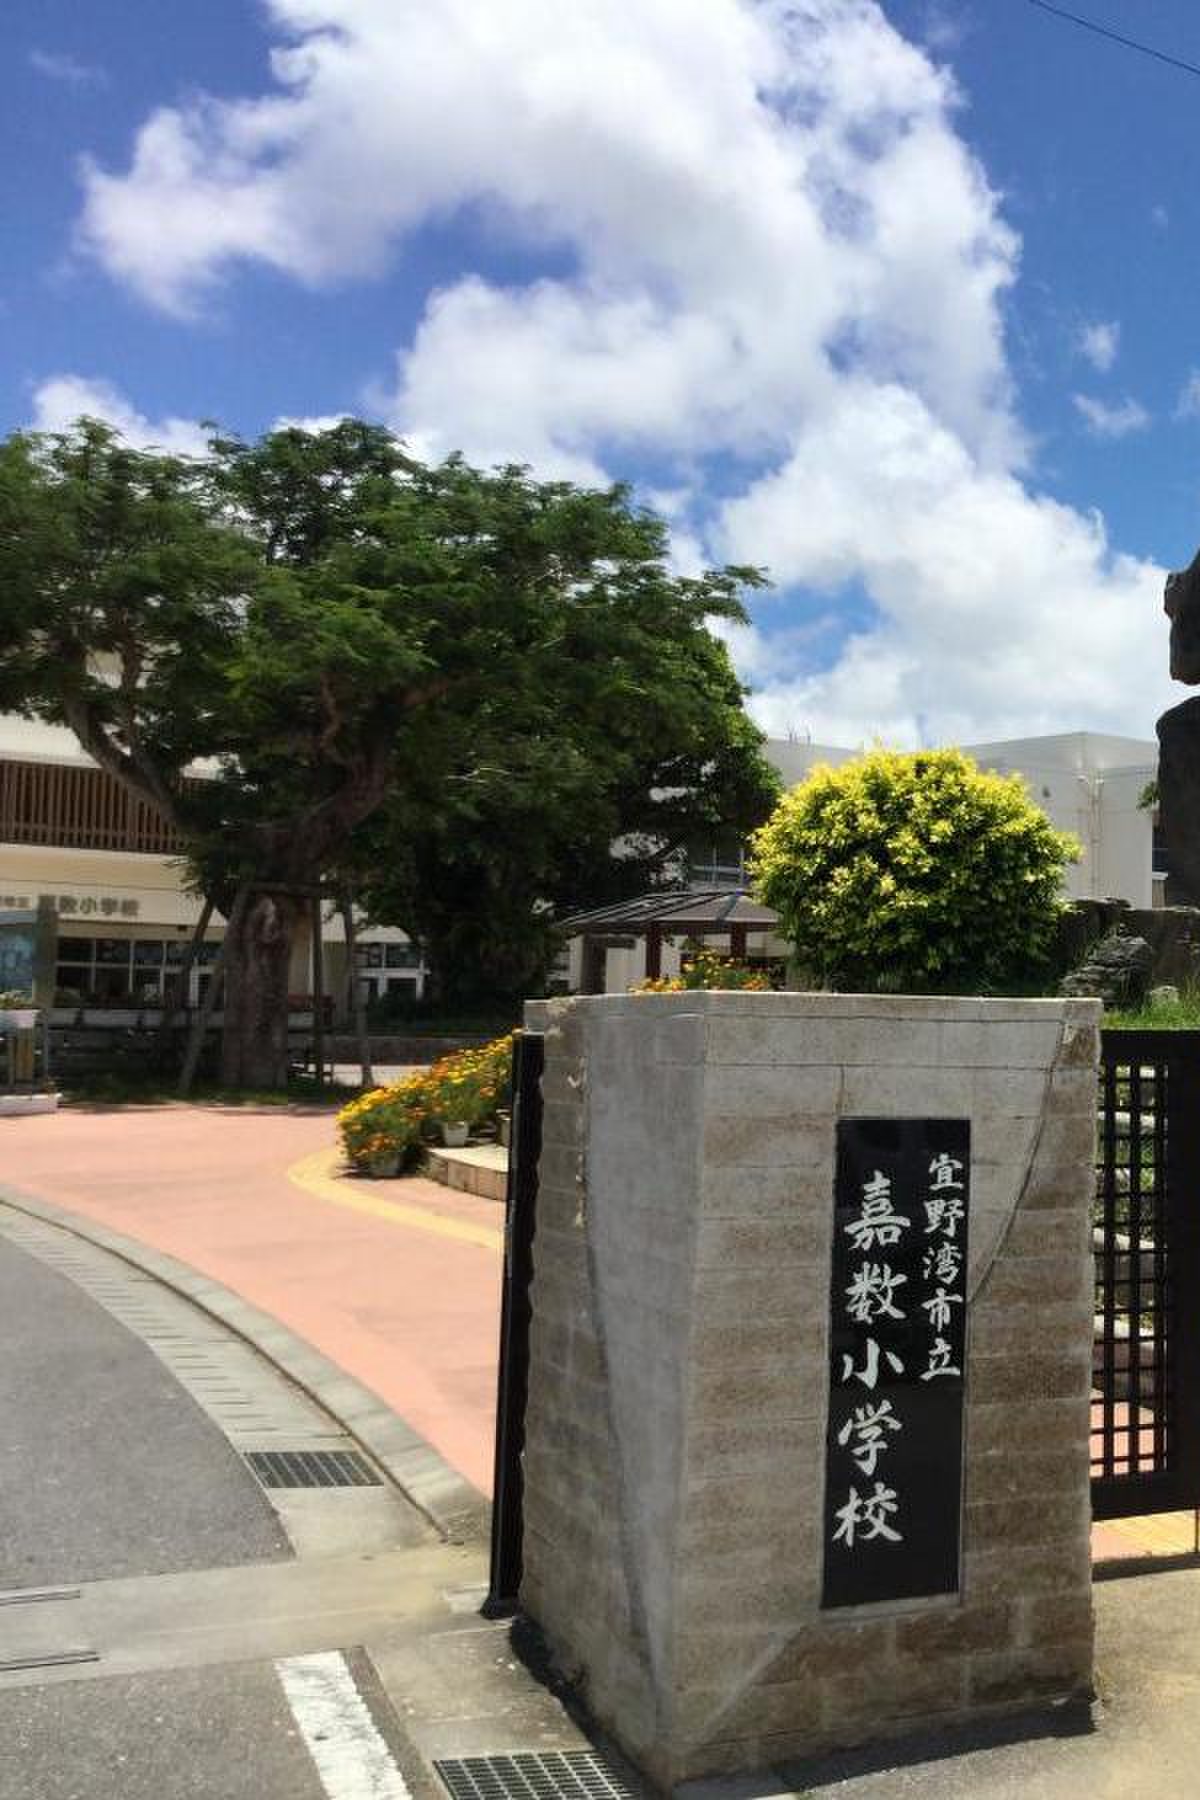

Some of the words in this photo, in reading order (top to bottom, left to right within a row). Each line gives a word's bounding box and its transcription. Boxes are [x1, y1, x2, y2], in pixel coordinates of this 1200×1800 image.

[832, 1169, 911, 1547] 嘉数小学校
[920, 1152, 964, 1382] 宜野湾市立
